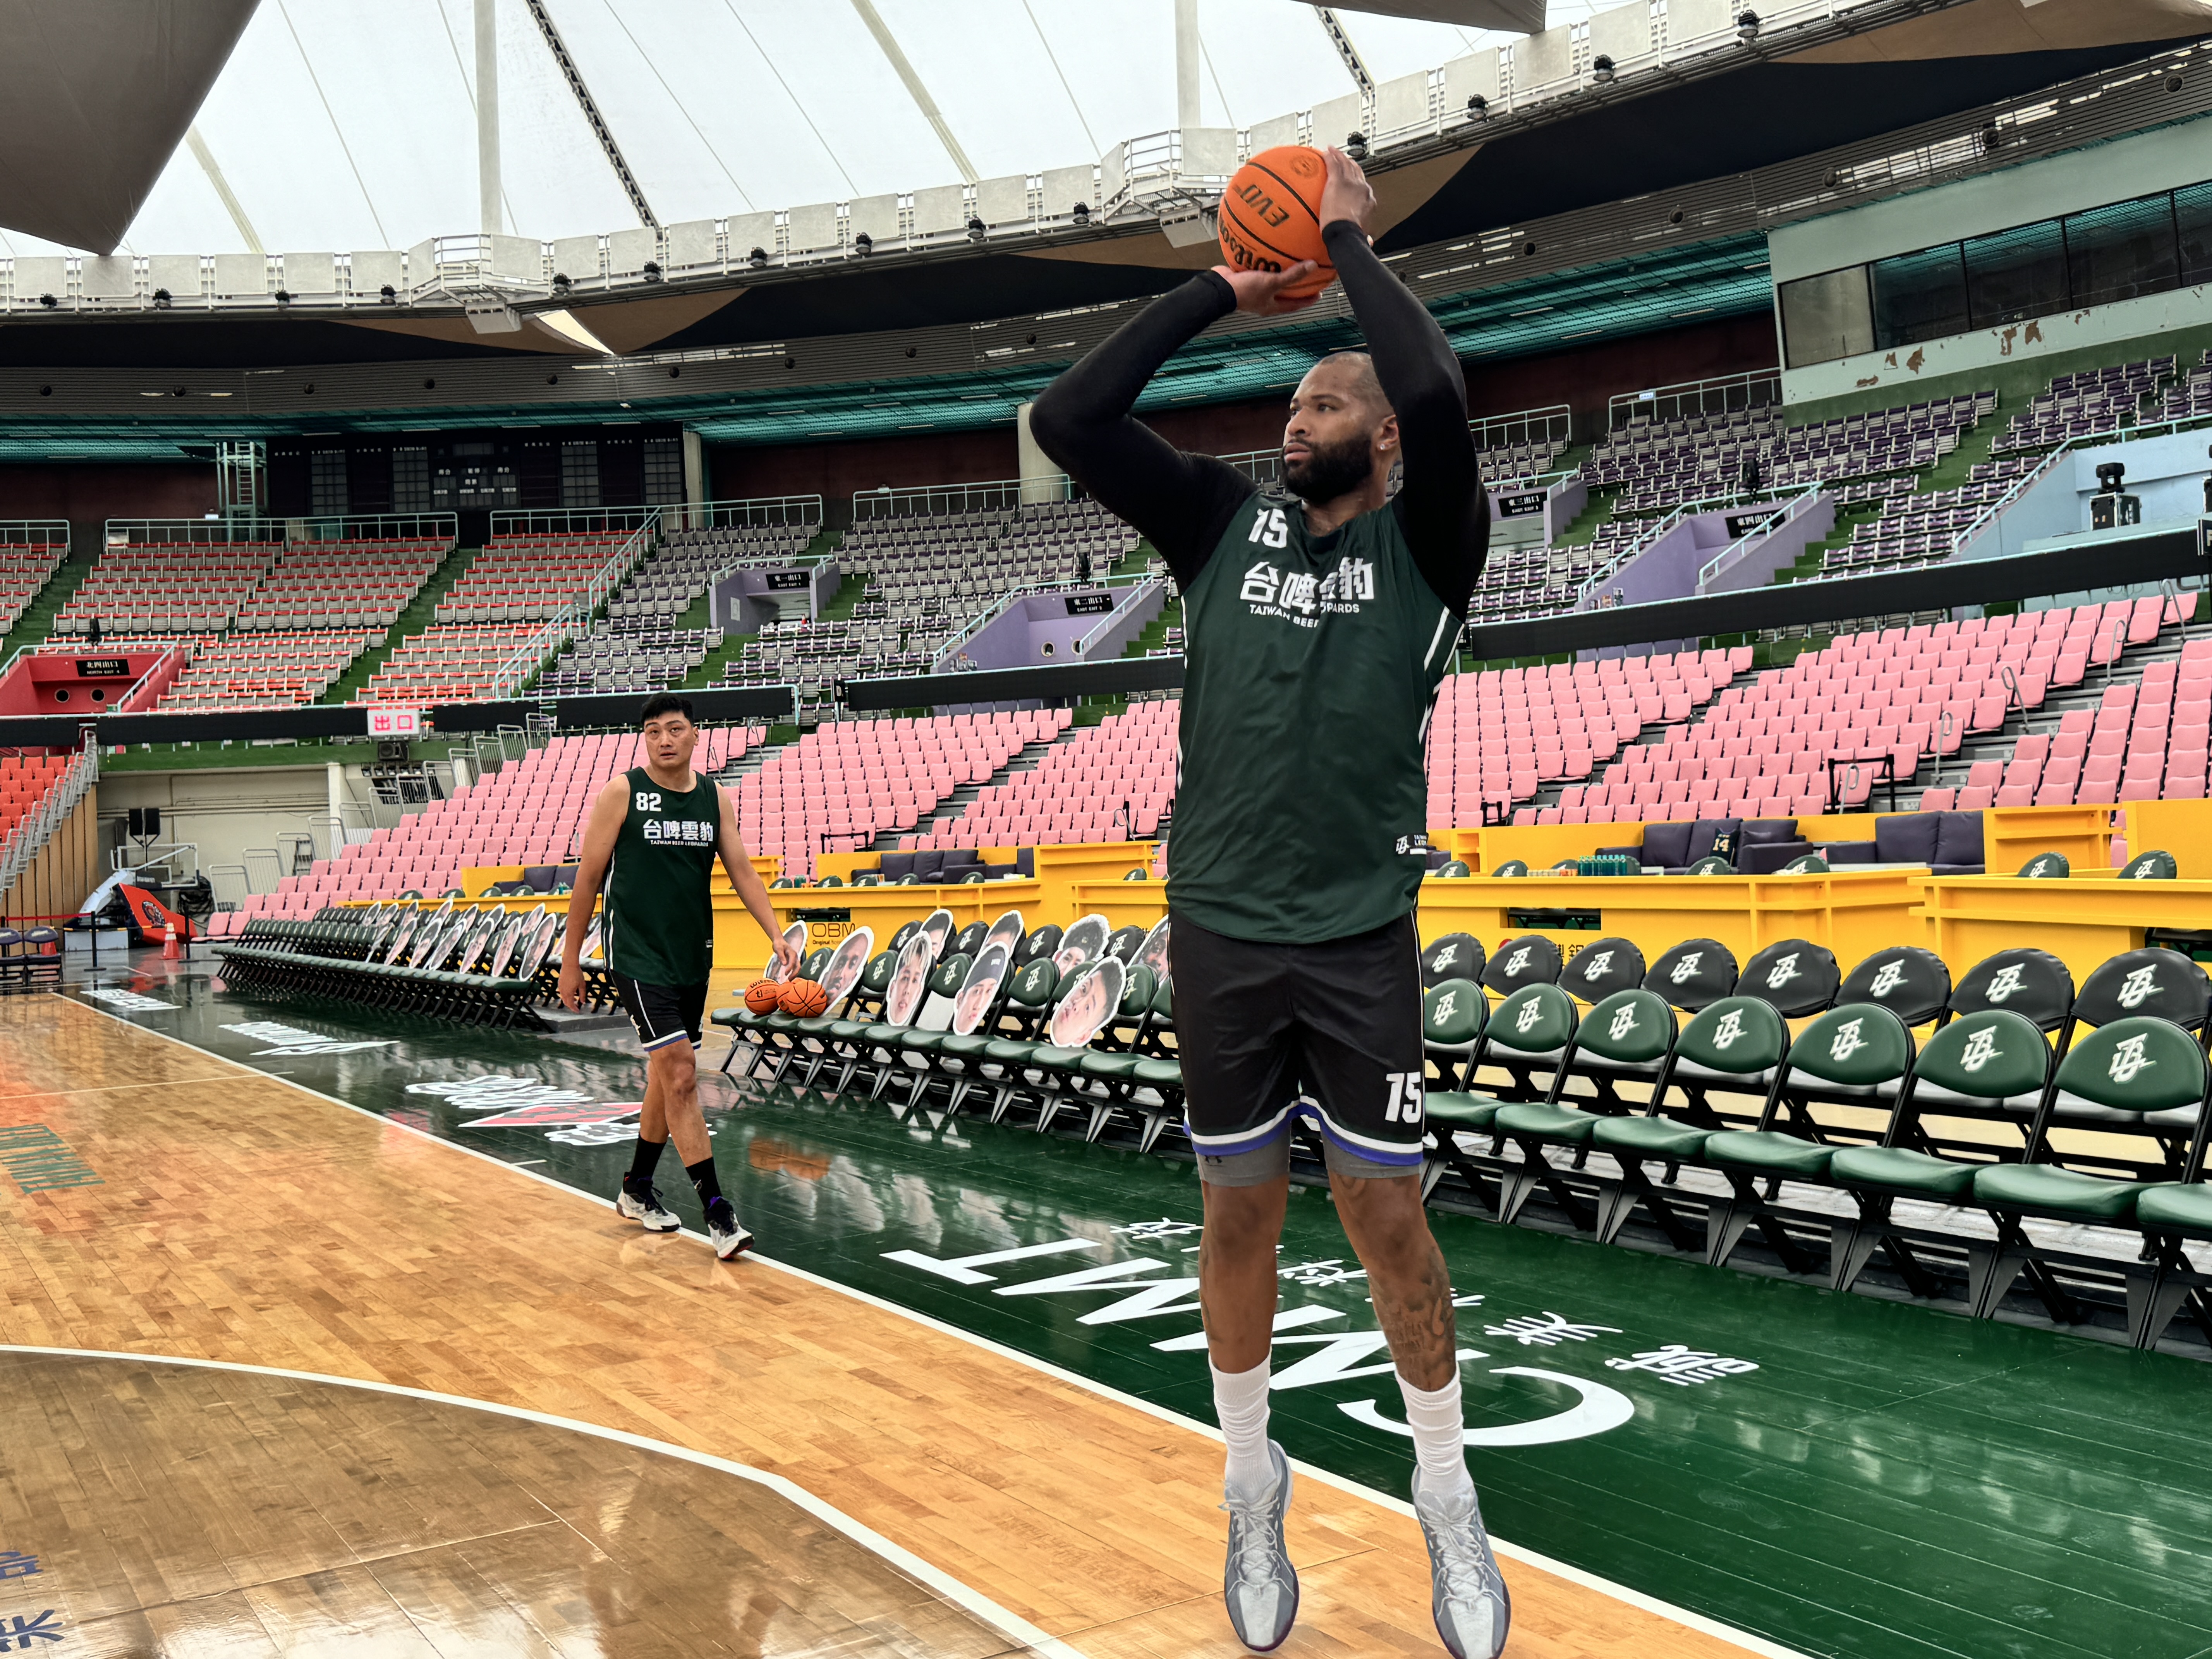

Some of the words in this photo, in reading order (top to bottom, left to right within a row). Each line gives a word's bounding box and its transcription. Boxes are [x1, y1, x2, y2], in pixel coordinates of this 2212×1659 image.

[1248, 508, 1288, 548] 15
[1250, 604, 1290, 620] TAIWAN
[374, 715, 412, 731] 出口
[636, 792, 661, 812] 82
[643, 819, 713, 842] 台啤雲豹
[1712, 838, 1729, 852] 14
[812, 923, 855, 937] OBM
[1385, 1071, 1422, 1123] 15
[1110, 1218, 1760, 1386] 誠美料技
[879, 1237, 1635, 1446] CMMT
